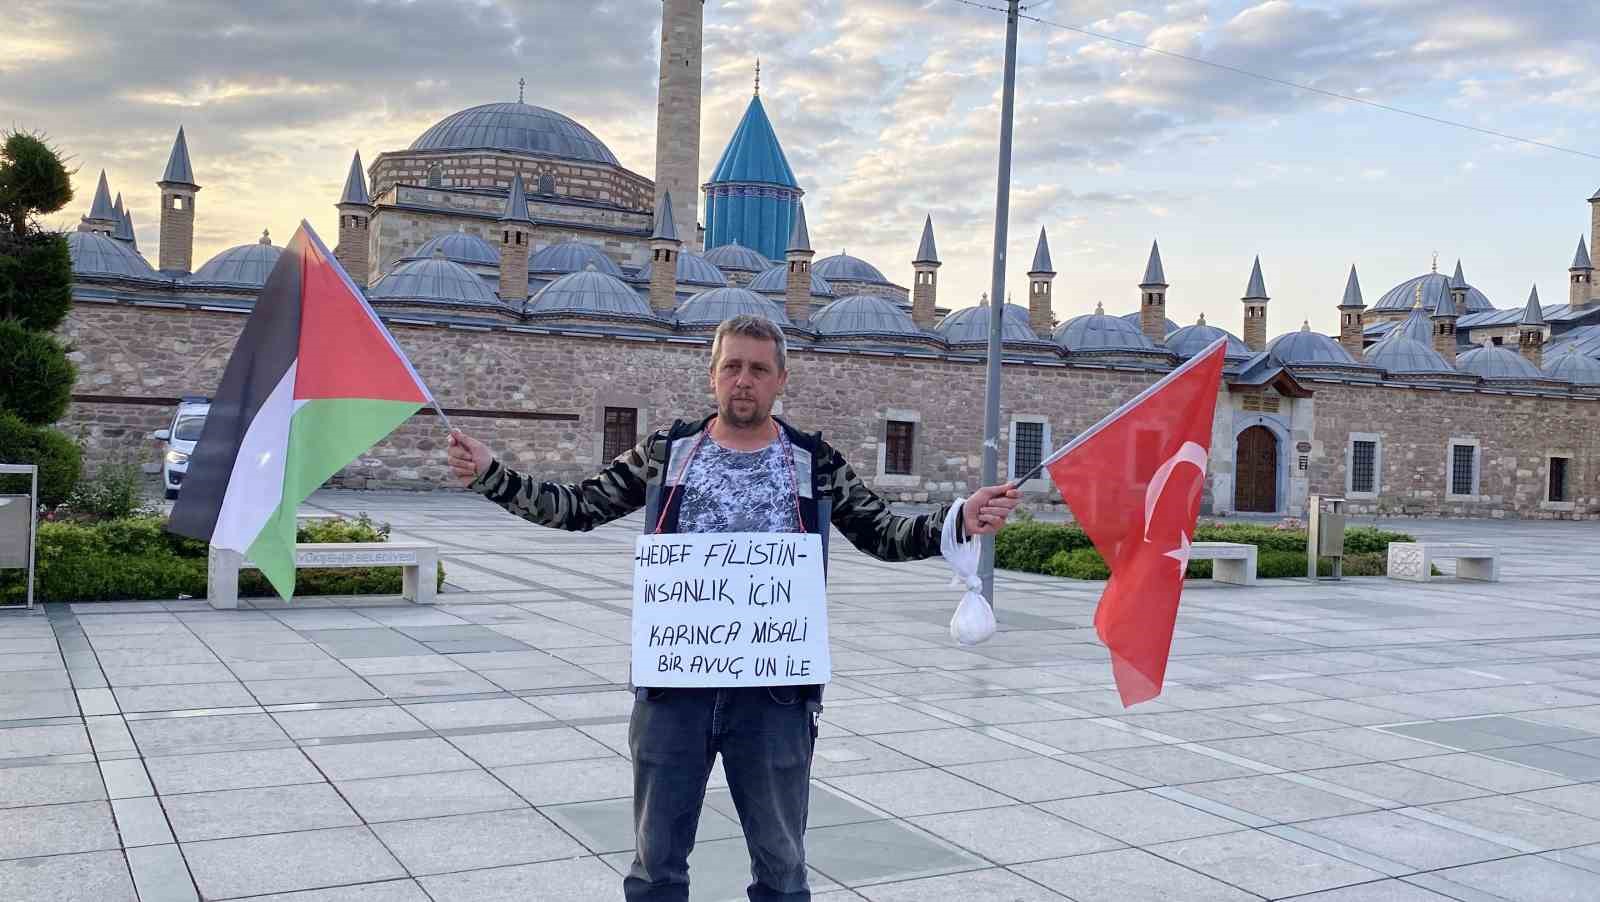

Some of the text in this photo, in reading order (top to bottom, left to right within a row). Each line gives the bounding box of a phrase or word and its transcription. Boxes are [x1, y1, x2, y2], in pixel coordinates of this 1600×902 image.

[645, 575, 790, 607] İNSANLIK İÇİN
[649, 617, 807, 647] KARINCA MİSALİ
[658, 653, 810, 679] BİR AVUÇ UN İLE
